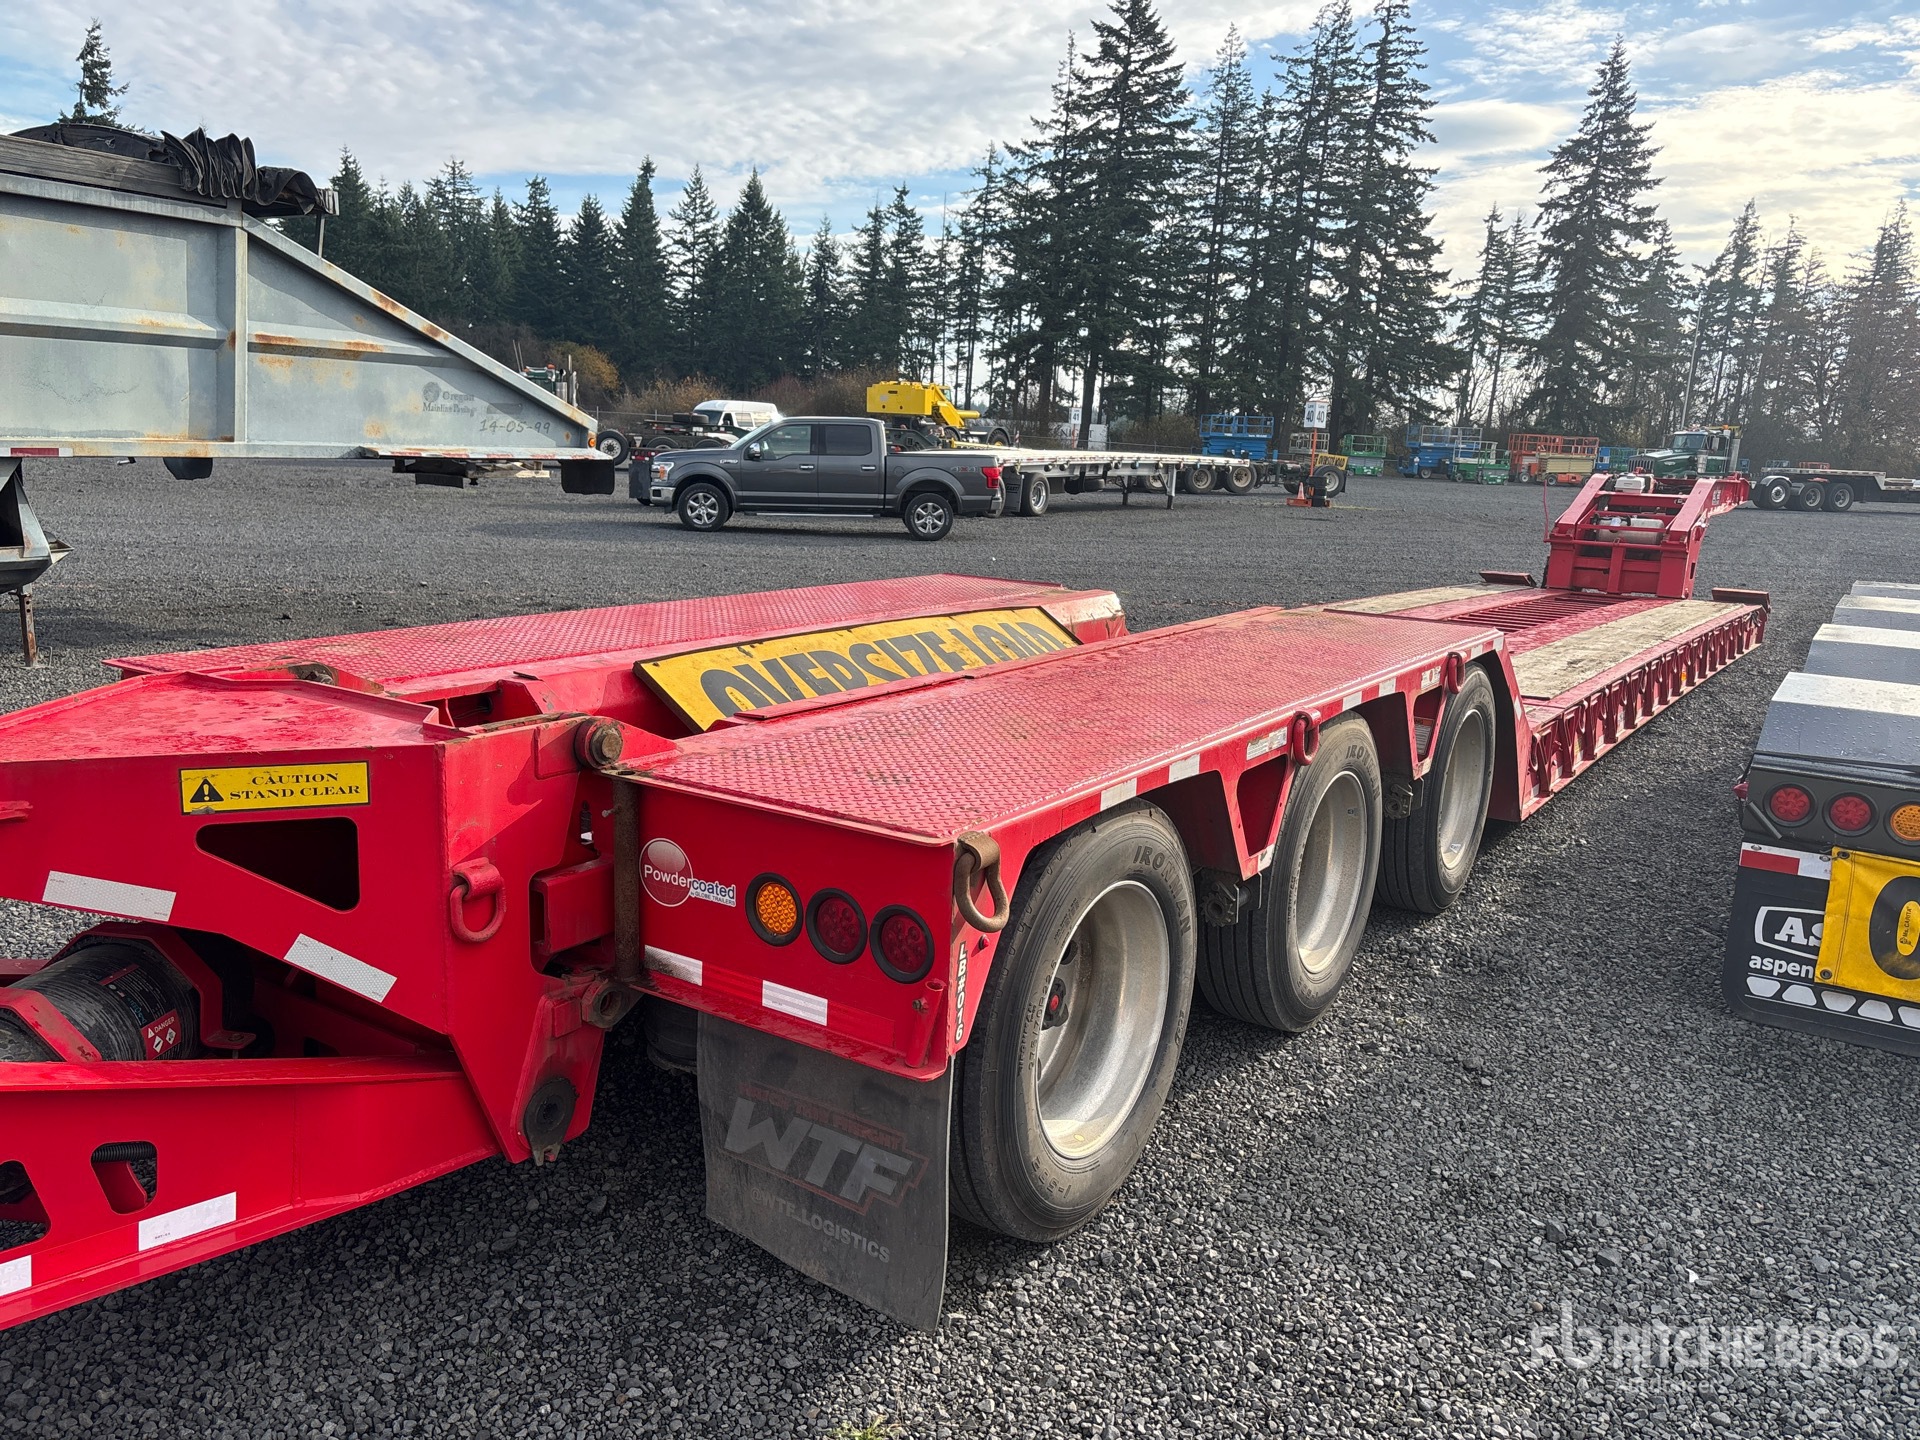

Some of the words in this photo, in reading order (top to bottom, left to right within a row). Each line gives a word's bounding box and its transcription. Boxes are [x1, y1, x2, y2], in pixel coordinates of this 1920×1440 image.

[442, 391, 475, 403] Oregon
[422, 402, 452, 413] Mainline
[1073, 413, 1080, 421] 41
[1306, 410, 1314, 422] 40
[1317, 411, 1325, 423] 40
[479, 418, 551, 434] 14-05-99
[251, 772, 339, 786] CAUTION
[229, 788, 295, 800] STAND
[299, 785, 361, 797] CLEAR
[1133, 845, 1191, 936] IRONMAN
[695, 892, 711, 900] GLOBE
[712, 895, 736, 907] TRAILERS
[154, 1016, 175, 1033] DANGER
[724, 1096, 913, 1204] WTF
